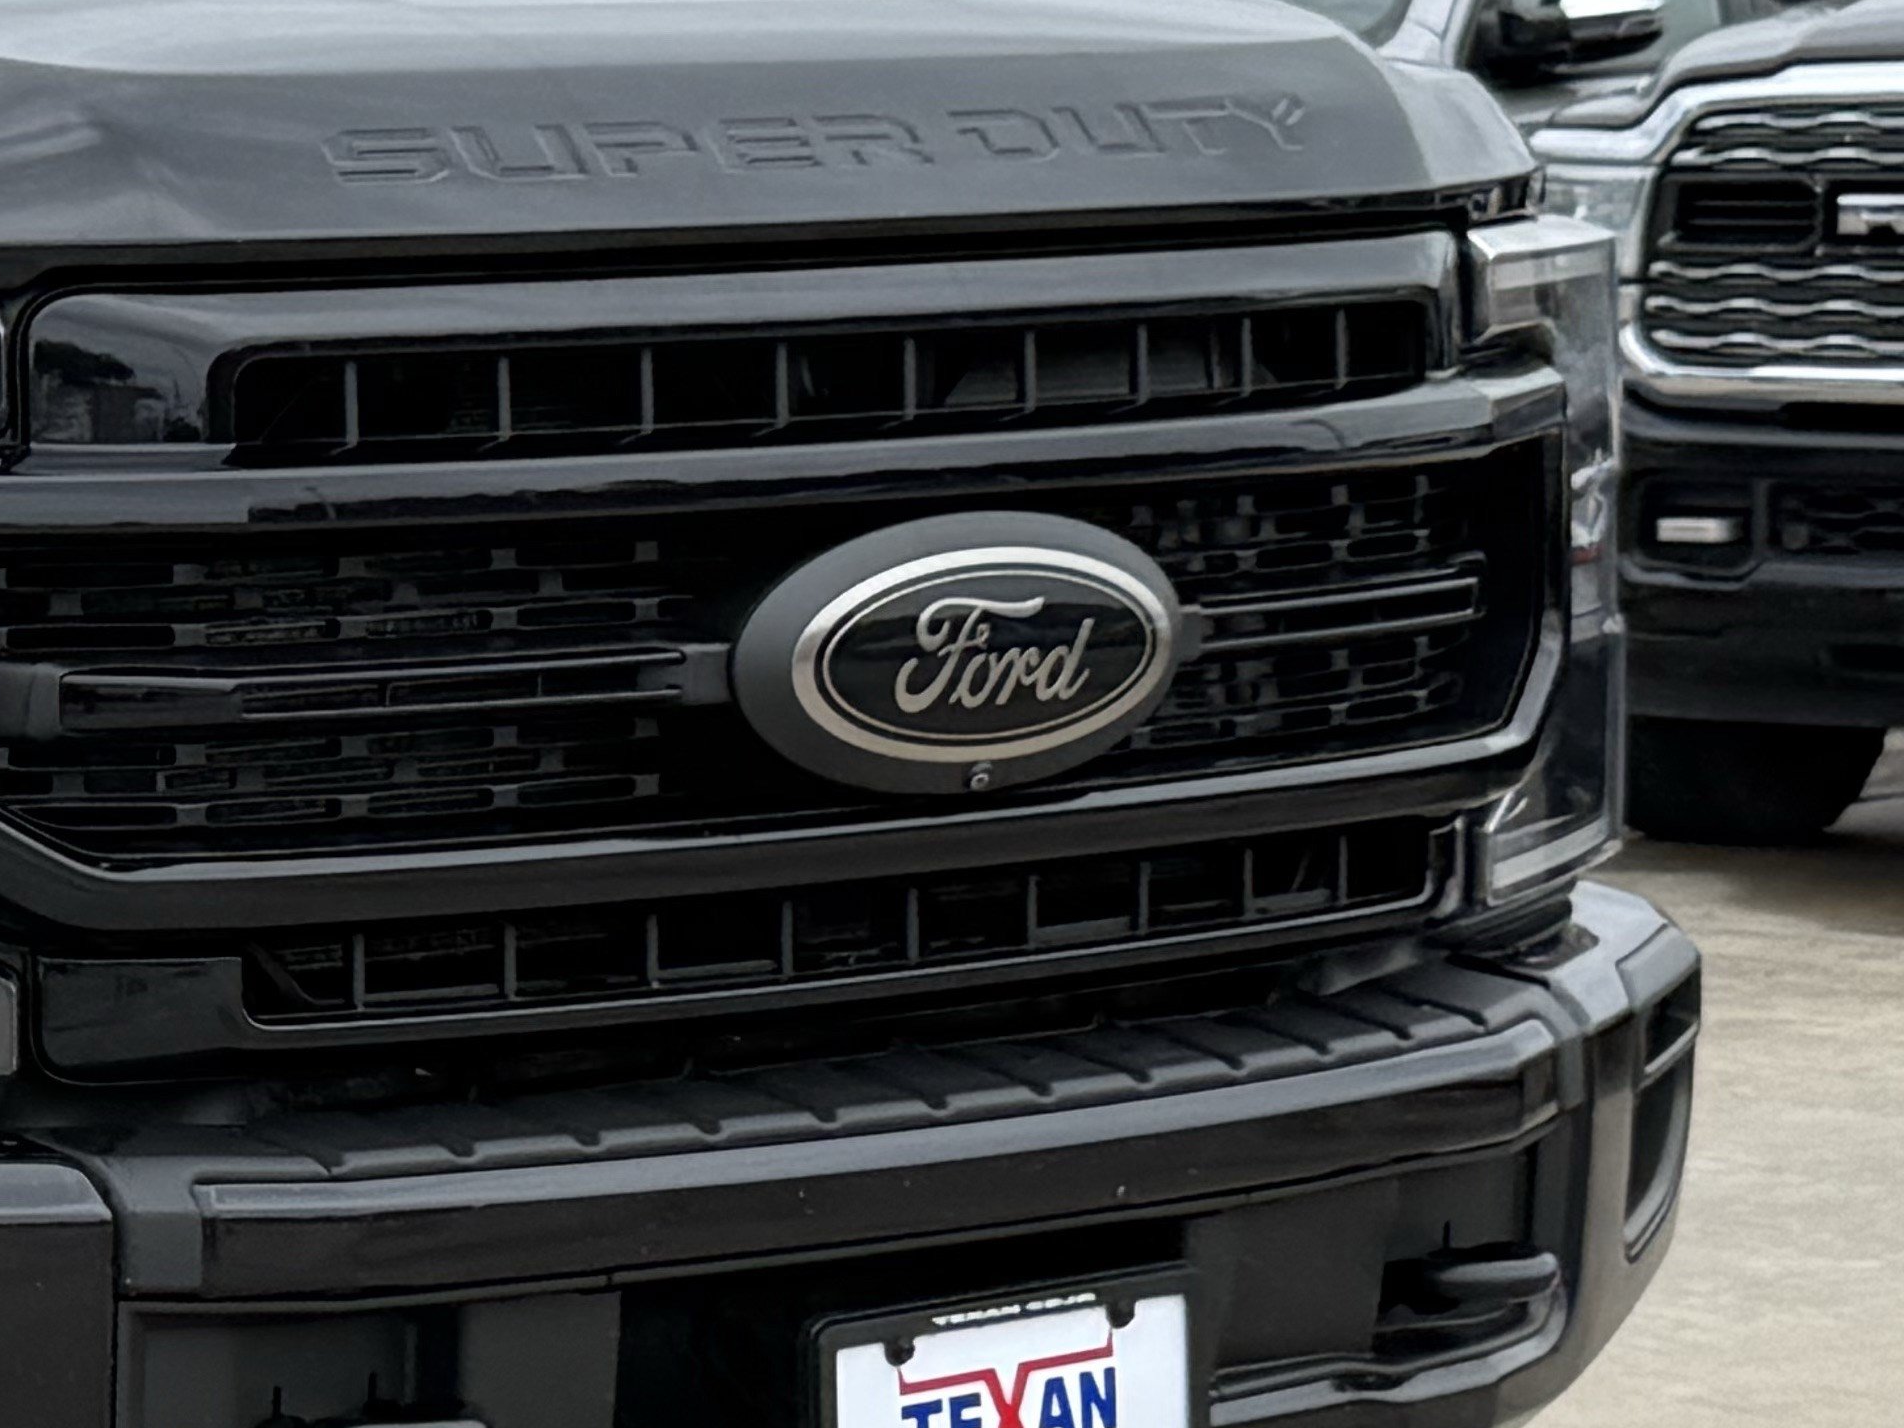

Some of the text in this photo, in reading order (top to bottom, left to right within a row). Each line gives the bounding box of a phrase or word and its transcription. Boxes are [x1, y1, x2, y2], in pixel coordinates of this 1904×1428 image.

[322, 95, 1309, 184] SUPER DUTY
[894, 595, 1096, 714] Ford
